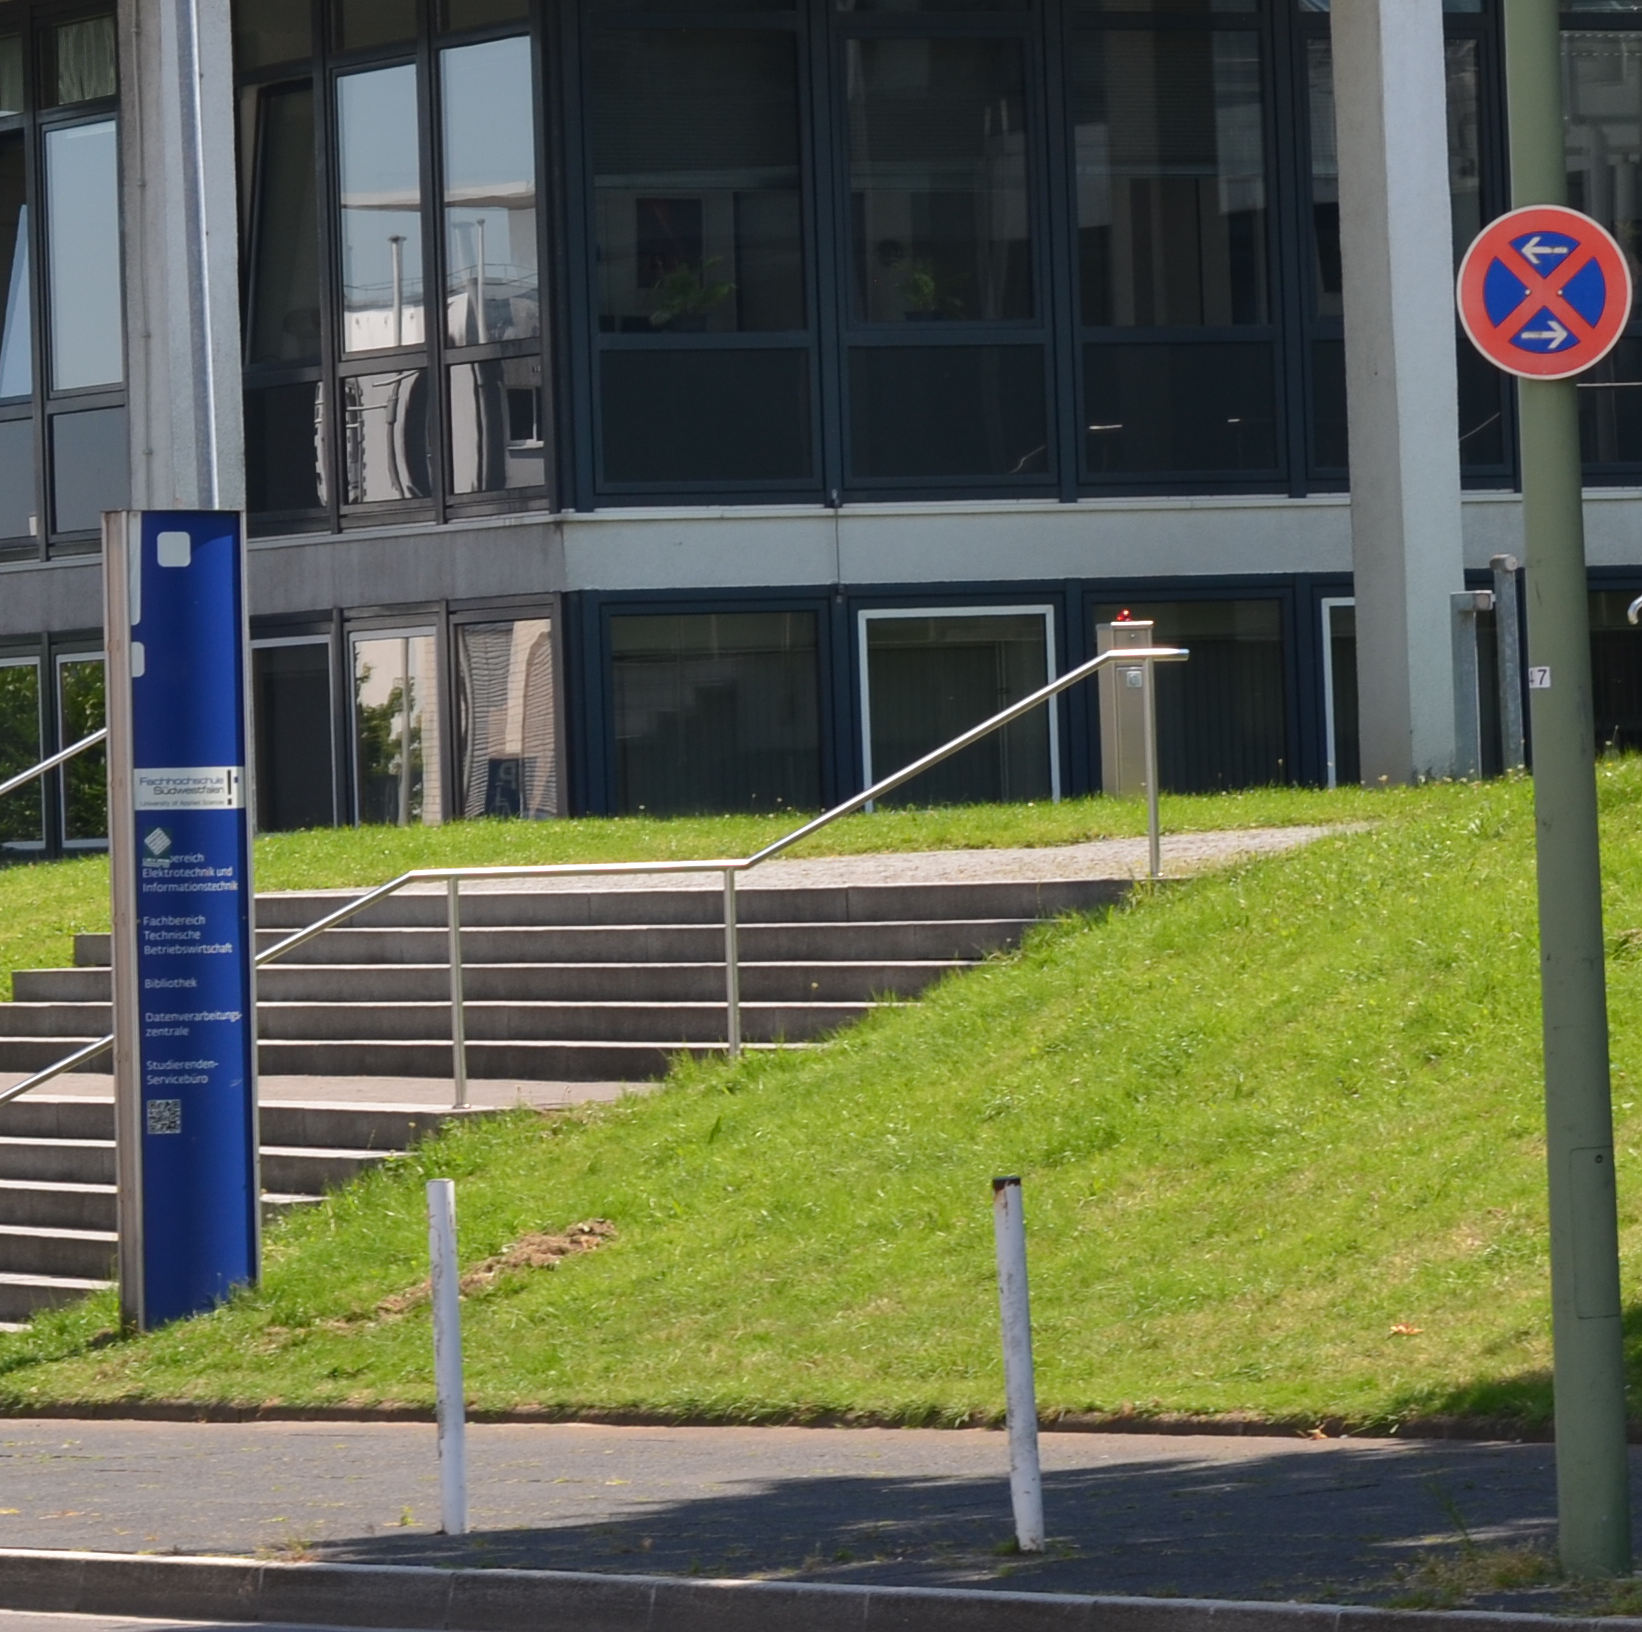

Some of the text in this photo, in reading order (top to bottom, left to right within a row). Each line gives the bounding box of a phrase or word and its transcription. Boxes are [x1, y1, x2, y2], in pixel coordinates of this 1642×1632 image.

[139, 776, 224, 786] Fachhochschule
[153, 785, 224, 795] Südwestfalen
[142, 866, 233, 878] Elektrotechnik und
[142, 881, 238, 893] Informationstechnik
[142, 915, 206, 926] Fachbereich
[143, 929, 201, 940] Technische
[143, 943, 233, 955] Betriebswirtschaft
[144, 977, 197, 988] Bibliothek
[145, 1026, 189, 1037] zentrale
[145, 1059, 219, 1070] Studierenden-
[145, 1073, 209, 1085] Servicebüro
